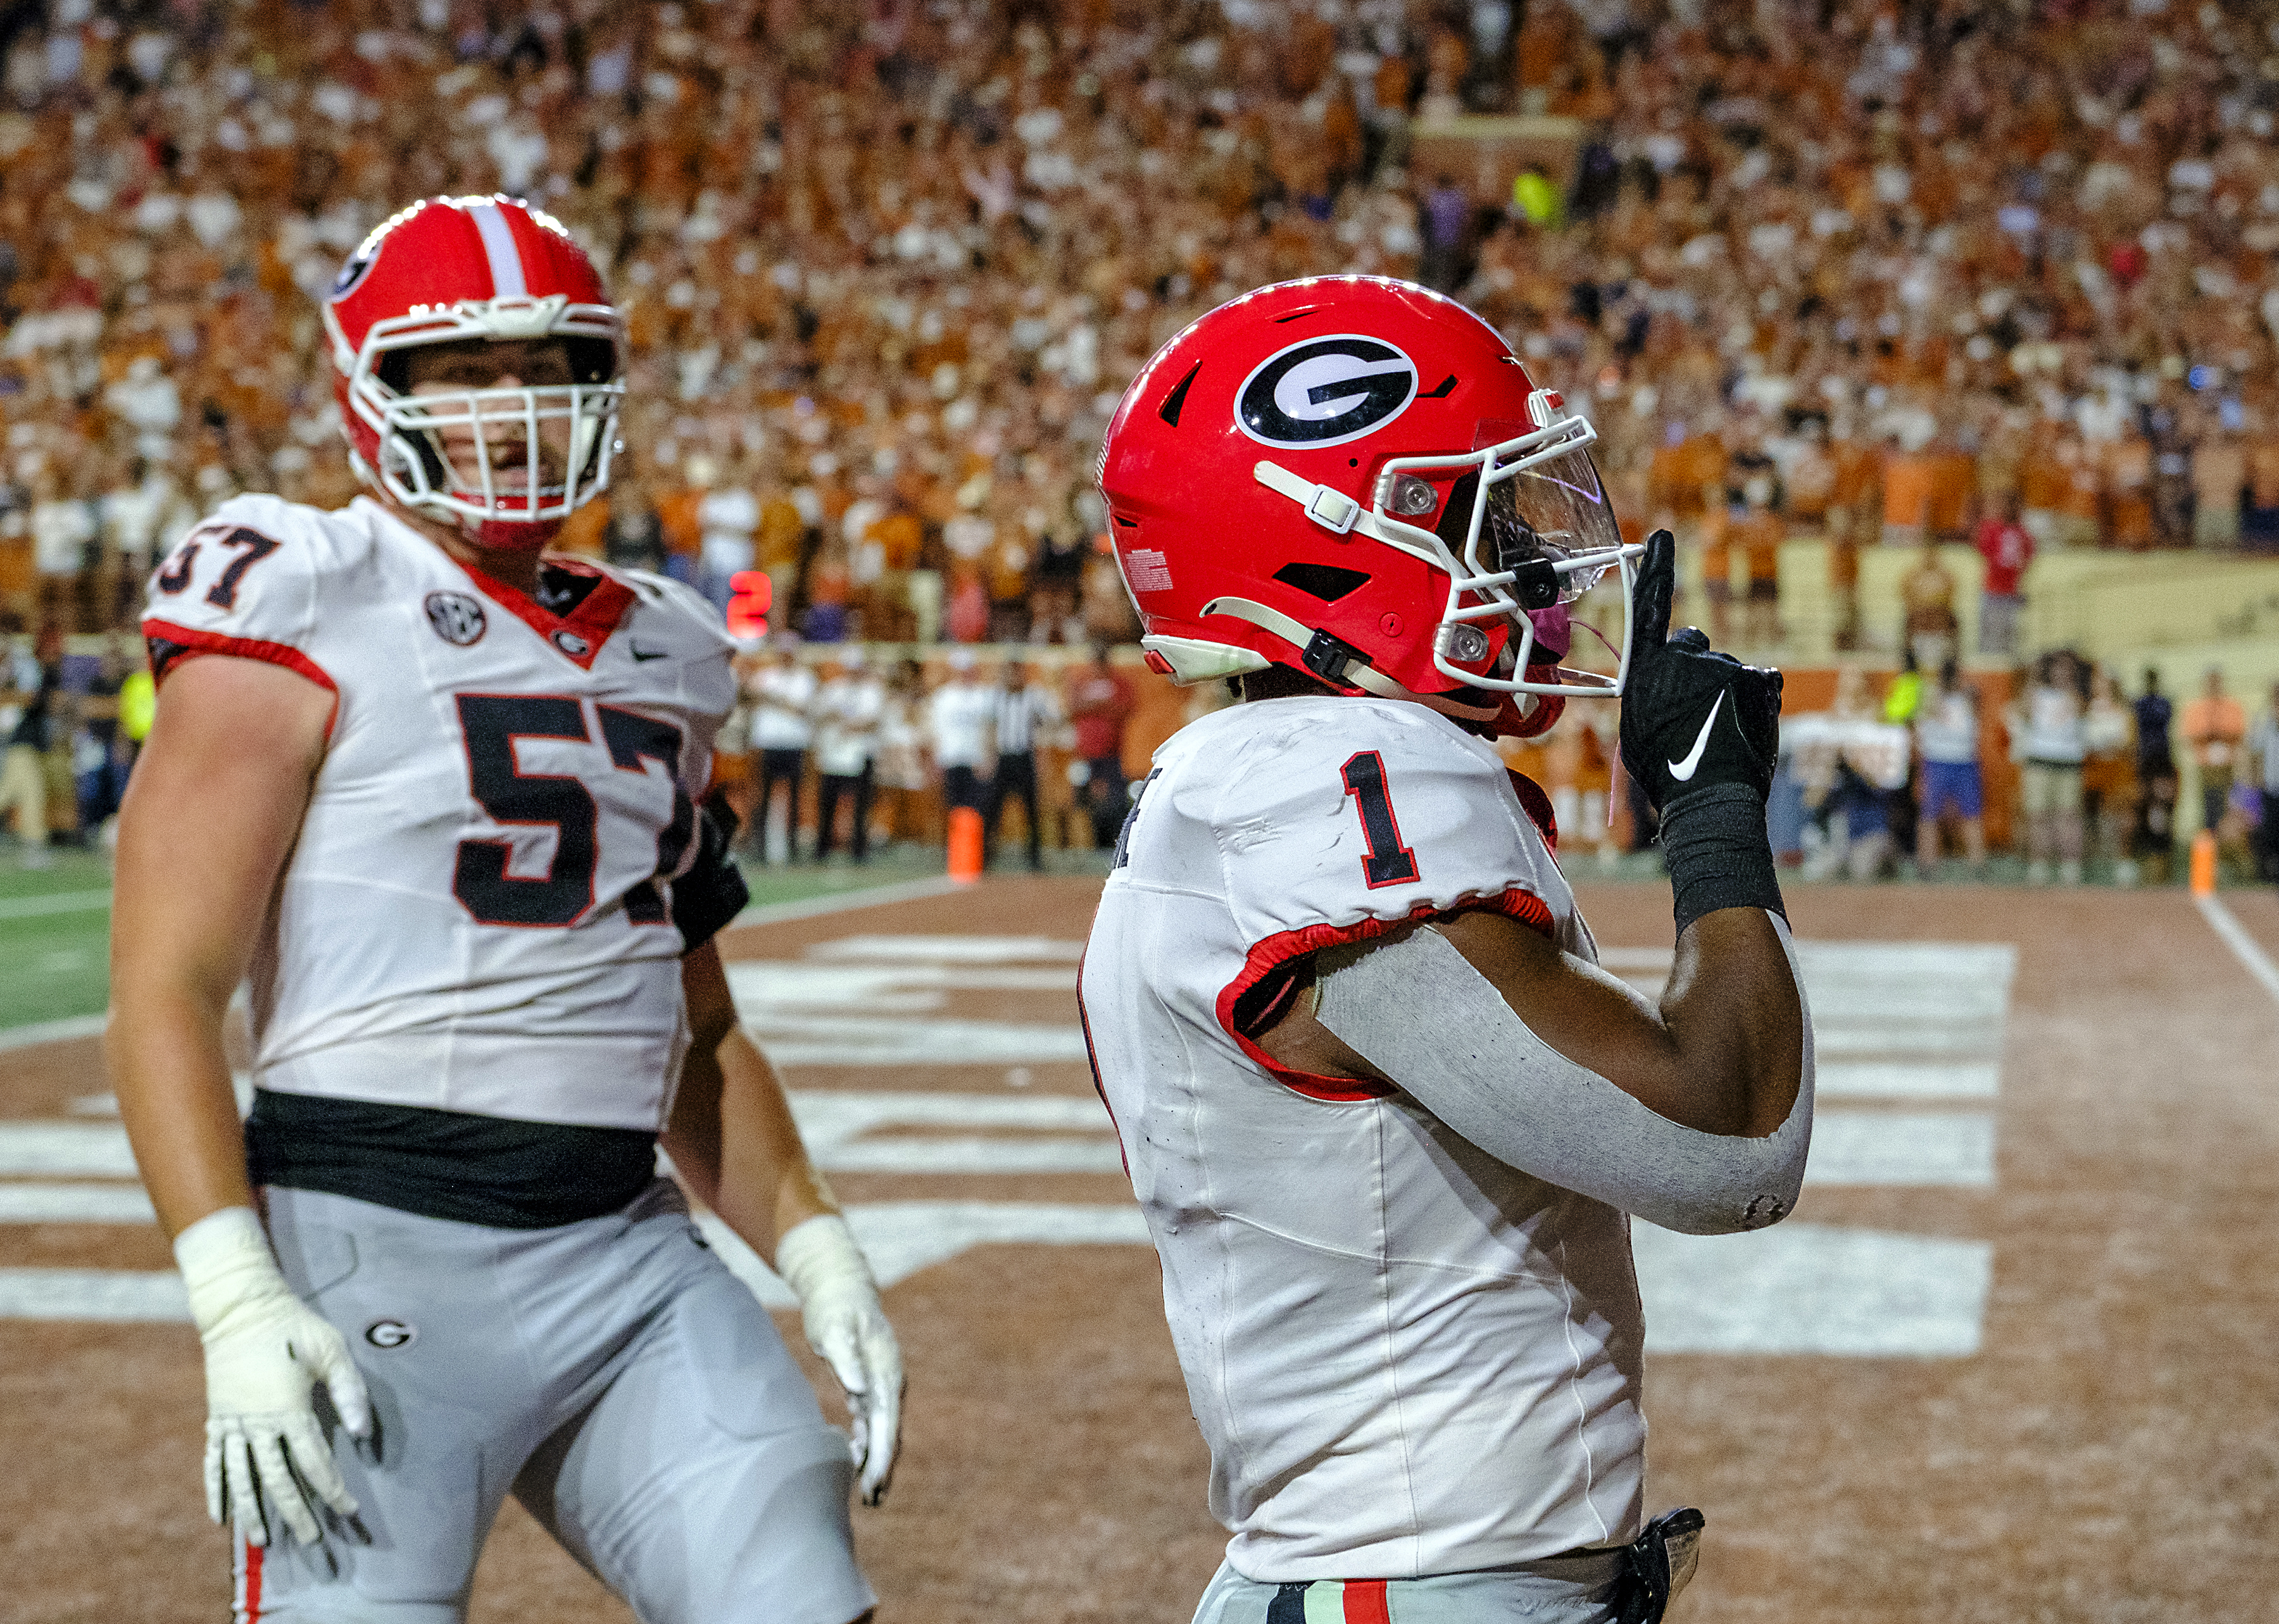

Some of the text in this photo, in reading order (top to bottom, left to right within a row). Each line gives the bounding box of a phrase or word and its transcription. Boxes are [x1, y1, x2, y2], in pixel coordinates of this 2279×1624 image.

[1240, 338, 1414, 443] G
[159, 527, 282, 609] 57
[727, 571, 772, 639] 2
[452, 692, 696, 928] 57
[1340, 750, 1421, 890] 1
[365, 1319, 410, 1349] G
